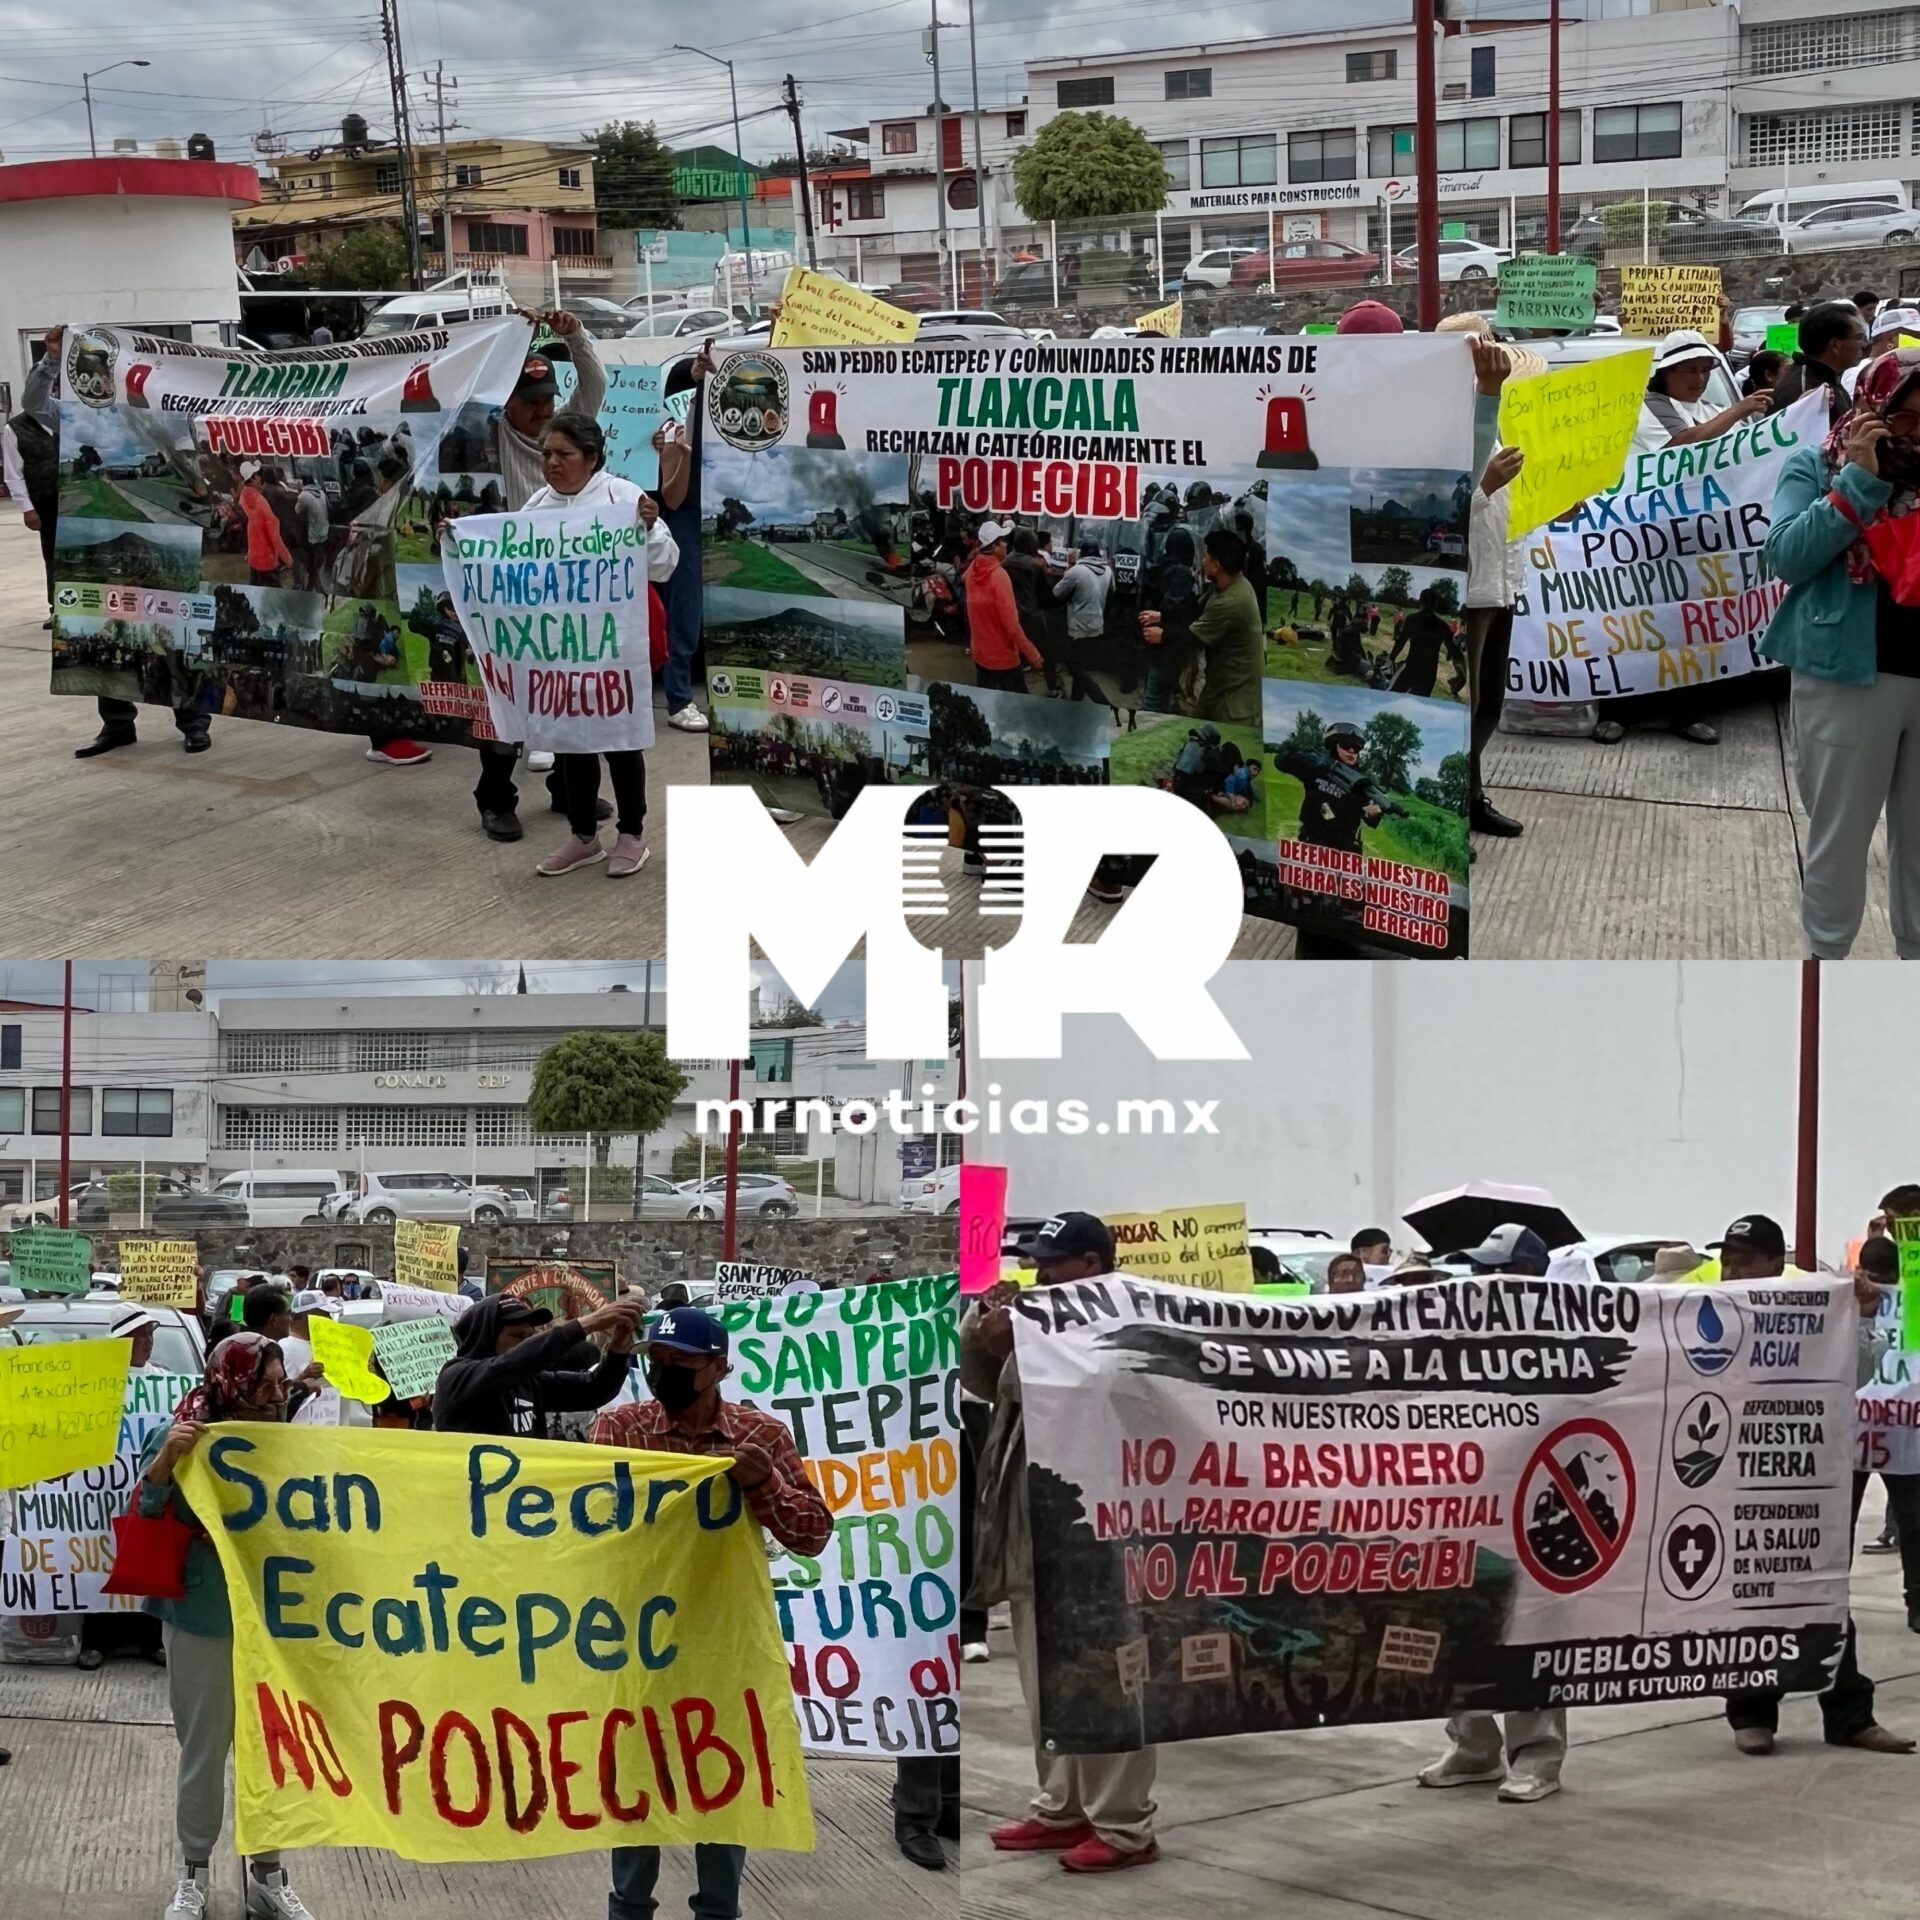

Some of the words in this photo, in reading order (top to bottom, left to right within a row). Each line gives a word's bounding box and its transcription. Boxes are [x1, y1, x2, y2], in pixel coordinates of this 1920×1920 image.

[1190, 193, 1249, 208] MATERIALES
[1251, 192, 1277, 205] PARA
[1279, 184, 1361, 203] CONSTRUCCIÓN
[1508, 301, 1585, 320] BARRANCAS
[132, 336, 158, 354] SAN
[431, 330, 450, 351] DE
[803, 351, 837, 374] SAN
[841, 351, 898, 374] PEDRO
[902, 349, 991, 374] ECATEPEC
[994, 348, 1006, 374] Y
[1009, 347, 1155, 374] COMUNIDADES
[1160, 345, 1282, 374] HERMANAS
[1288, 345, 1318, 374] DE
[937, 377, 1140, 433] TLAXCALA
[866, 429, 970, 456] RECHAZAN
[975, 431, 1177, 465] CATEÓRICAMENTE
[1183, 440, 1207, 467] EL
[1637, 411, 1799, 493] ECATEPEC
[937, 455, 1140, 521] PODECIBI
[1520, 466, 1547, 499] NO
[499, 520, 555, 561] Pedro
[559, 515, 648, 564] Ecatepec
[1530, 536, 1556, 570] al
[1540, 558, 1689, 617] MUNICIPIO
[1696, 553, 1738, 598] SE
[1547, 619, 1591, 660] DE
[1602, 609, 1666, 656] SUS
[1587, 655, 1635, 696] EL
[1658, 646, 1729, 688] ART.
[528, 668, 635, 721] PODECIBI
[1279, 839, 1364, 875] DEFENDER
[1366, 856, 1450, 896] NUESTRA
[1277, 862, 1338, 896] TIERRA
[1340, 877, 1364, 900] ES
[1365, 881, 1449, 923] NUESTRO
[1364, 905, 1449, 950] DERECHO
[478, 1074, 512, 1089] SEP
[1172, 1217, 1199, 1240] NO
[19, 1266, 82, 1286] BARRANCAS
[541, 1271, 549, 1285] Y
[718, 1264, 752, 1284] SAN
[756, 1266, 803, 1286] PEDRO
[658, 1313, 677, 1335] LA
[1013, 1281, 1120, 1336] SAN
[1121, 1280, 1361, 1331] FRANCISCO
[1370, 1280, 1641, 1333] ATEXCATZINGO
[1753, 1312, 1825, 1336] NUESTRA
[8, 1355, 72, 1374] Francisco
[738, 1329, 843, 1396] SAN
[1199, 1341, 1255, 1377] SE
[1262, 1348, 1353, 1379] UNE
[1365, 1349, 1390, 1380] A
[1403, 1348, 1448, 1381] LA
[1459, 1347, 1595, 1381] LUCHA
[1749, 1340, 1801, 1368] AGUA
[741, 1369, 960, 1458] TEPEC
[1216, 1399, 1265, 1428] POR
[1272, 1400, 1401, 1429] NUESTROS
[1407, 1401, 1540, 1430] DERECHOS
[1738, 1422, 1825, 1446] NUESTRA
[1121, 1437, 1177, 1487] NO
[1188, 1440, 1249, 1488] AL
[1263, 1440, 1485, 1489] BASURERO
[1736, 1451, 1817, 1478] TIERRA
[208, 1436, 382, 1533] San
[468, 1443, 744, 1539] Pedro
[1094, 1500, 1133, 1541] NO
[1140, 1499, 1174, 1535] AL
[1179, 1496, 1320, 1535] PARQUE
[1329, 1494, 1505, 1534] INDUSTRIAL
[1734, 1503, 1820, 1521] DEFENDEMOS
[20, 1538, 58, 1574] DE
[771, 1504, 954, 1589] STRO
[1735, 1528, 1759, 1551] LA
[1763, 1527, 1821, 1551] SALUD
[1125, 1541, 1177, 1604] NO
[1185, 1540, 1247, 1597] AL
[1259, 1537, 1479, 1596] PODECIBI
[1733, 1558, 1750, 1575] DE
[1753, 1555, 1813, 1574] NUESTRA
[51, 1573, 89, 1611] EL
[1732, 1581, 1776, 1599] GENTE
[263, 1556, 679, 1685] Ecatepec
[1531, 1637, 1672, 1679] PUEBLOS
[1682, 1633, 1800, 1668] UNIDOS
[1548, 1681, 1589, 1703] POR
[1593, 1680, 1622, 1703] UN
[1628, 1673, 1706, 1697] FUTURO
[1711, 1668, 1779, 1690] MEJOR
[799, 1696, 960, 1754] DECIB
[256, 1681, 354, 1798] NO
[378, 1687, 776, 1835] PODECIBI
